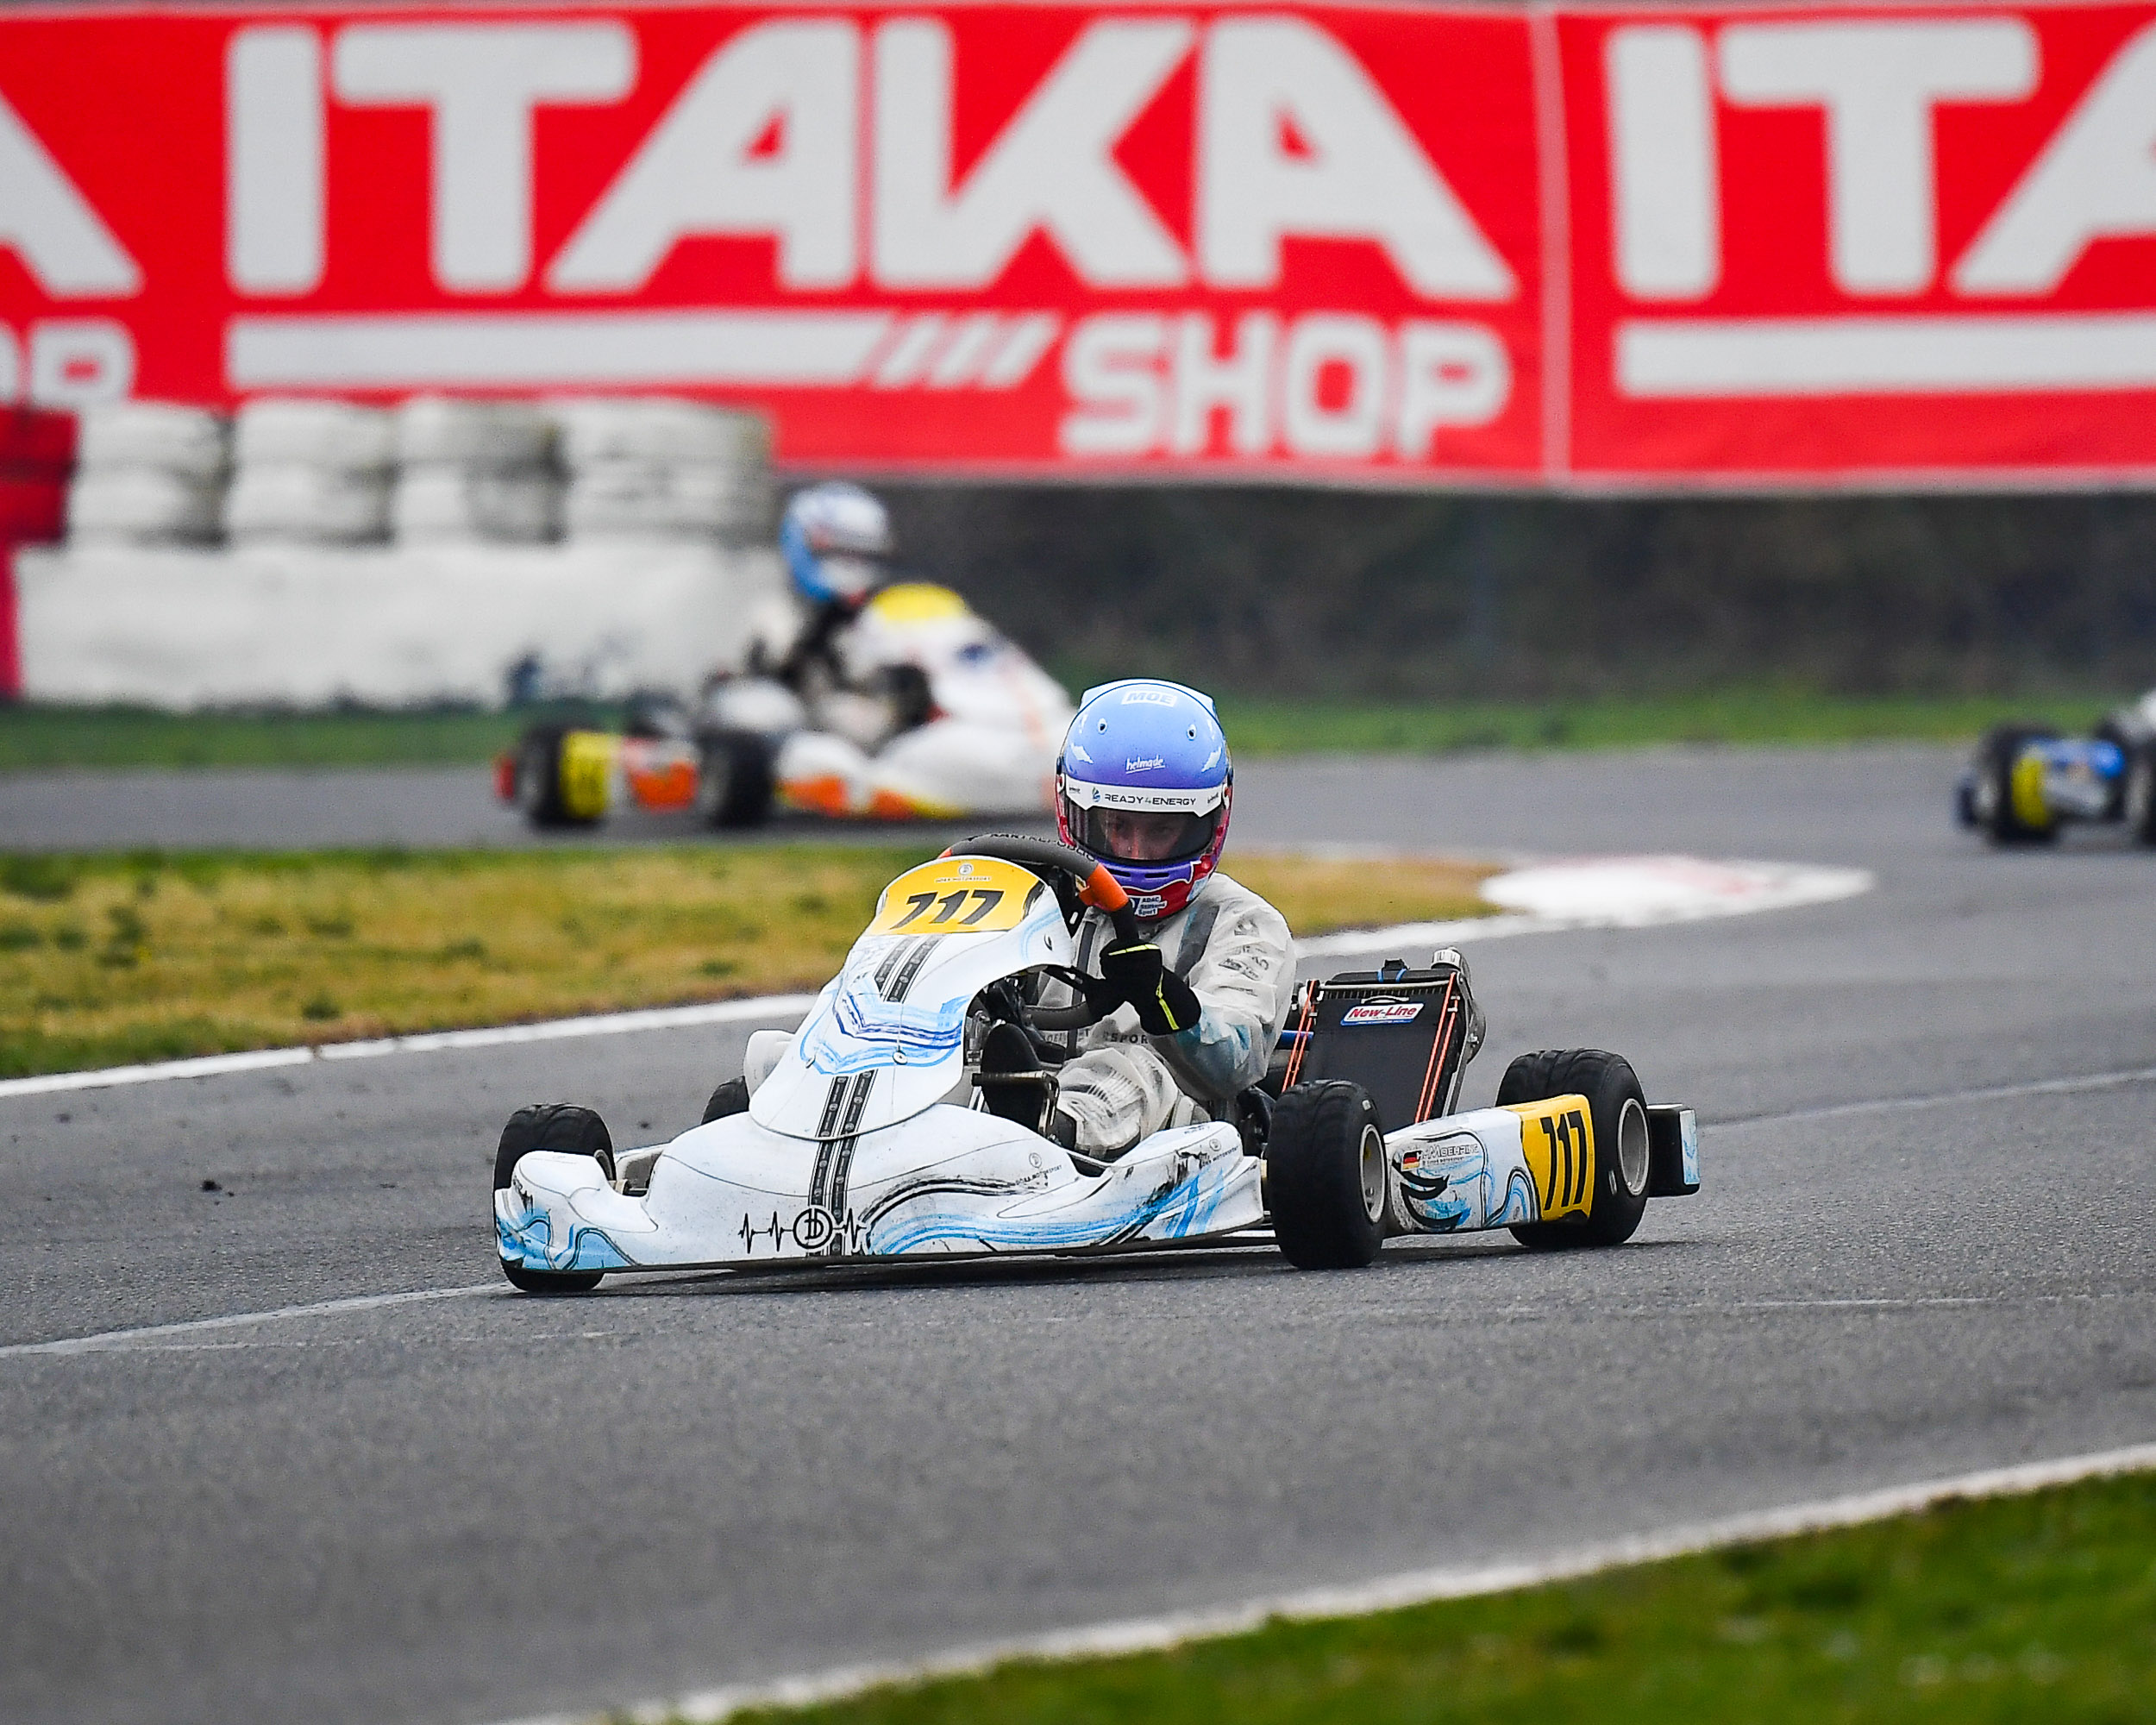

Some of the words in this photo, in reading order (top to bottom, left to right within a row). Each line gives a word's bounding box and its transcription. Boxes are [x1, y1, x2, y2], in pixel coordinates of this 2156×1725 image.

[224, 16, 1519, 300] ITAKA
[1059, 310, 1513, 461] SHOP
[1126, 693, 1173, 704] MOE
[1125, 755, 1165, 772] helmade
[889, 889, 1005, 930] 717
[1348, 1006, 1417, 1019] New-Line
[1539, 1110, 1586, 1211] 717
